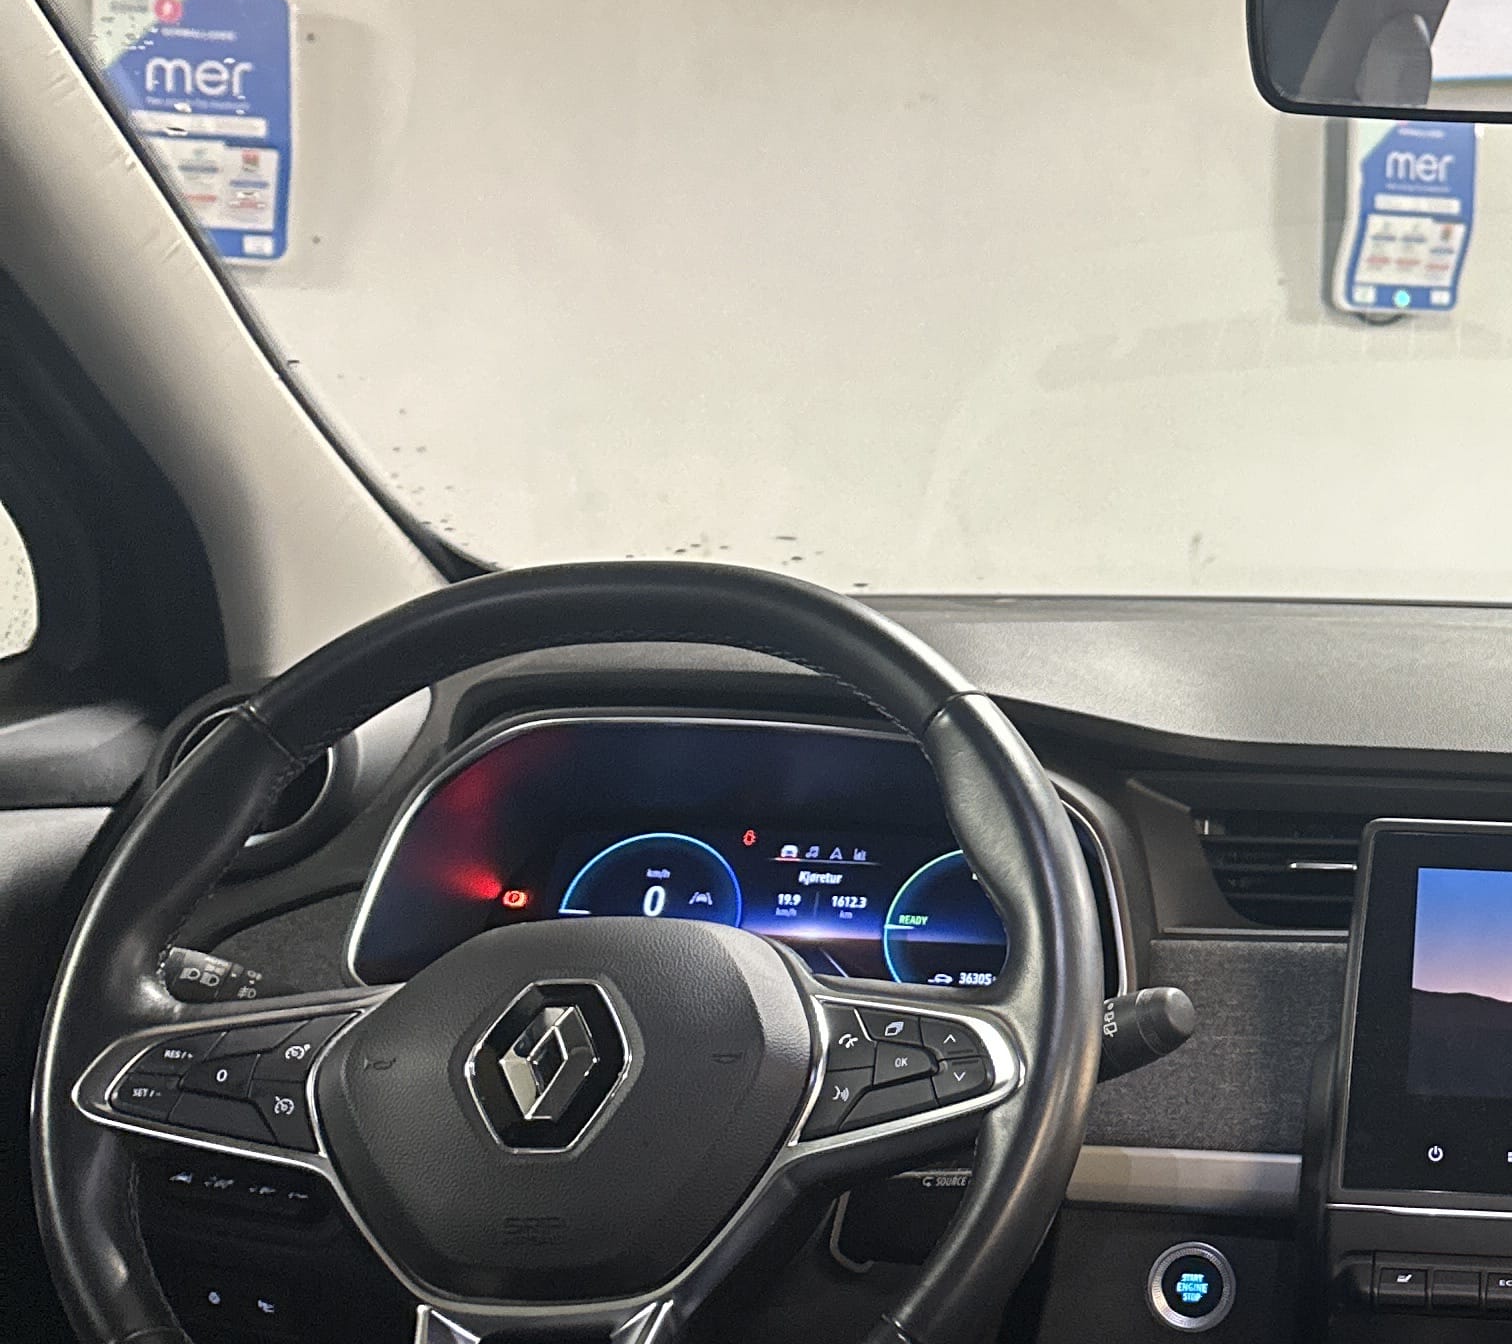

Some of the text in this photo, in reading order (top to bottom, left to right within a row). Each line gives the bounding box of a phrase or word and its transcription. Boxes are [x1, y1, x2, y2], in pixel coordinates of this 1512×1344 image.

[145, 56, 253, 96] mer
[1385, 152, 1455, 182] mer
[646, 868, 671, 879] km/h
[799, 870, 843, 884] Kjøretur
[643, 885, 666, 917] 0
[777, 893, 801, 906] 19.9
[832, 895, 867, 909] 1612.3
[776, 907, 797, 917] km/h
[899, 915, 928, 925] READY
[959, 972, 992, 985] 36305
[894, 1057, 909, 1068] OK
[935, 1176, 968, 1187] SOURCE
[1181, 1273, 1205, 1282] START
[1176, 1282, 1209, 1293] ENGINE
[1182, 1293, 1203, 1302] STOP
